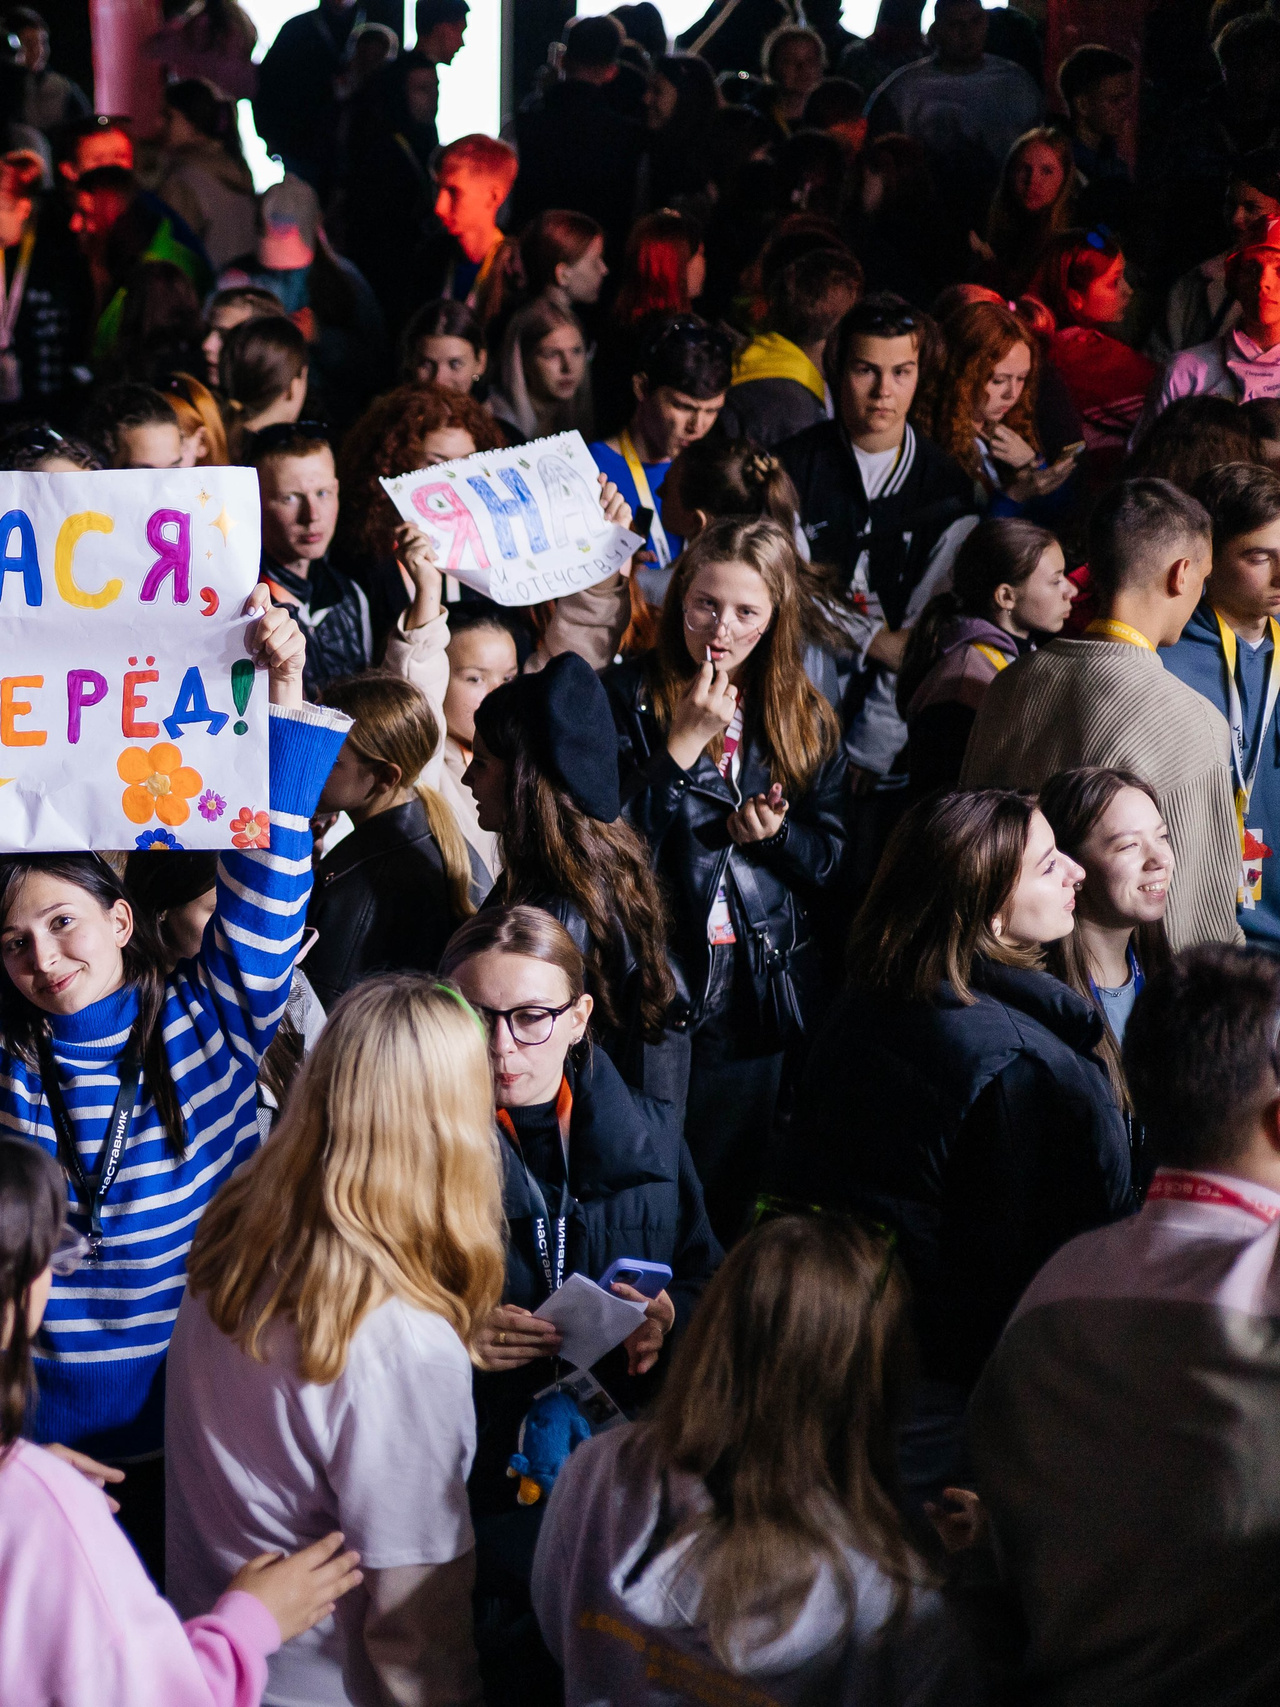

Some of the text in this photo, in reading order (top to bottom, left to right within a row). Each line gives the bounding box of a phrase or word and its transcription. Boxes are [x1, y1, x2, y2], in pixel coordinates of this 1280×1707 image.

[410, 454, 608, 570] ЯНА
[99, 1109, 129, 1195] наставник
[557, 1217, 565, 1289] ставник
